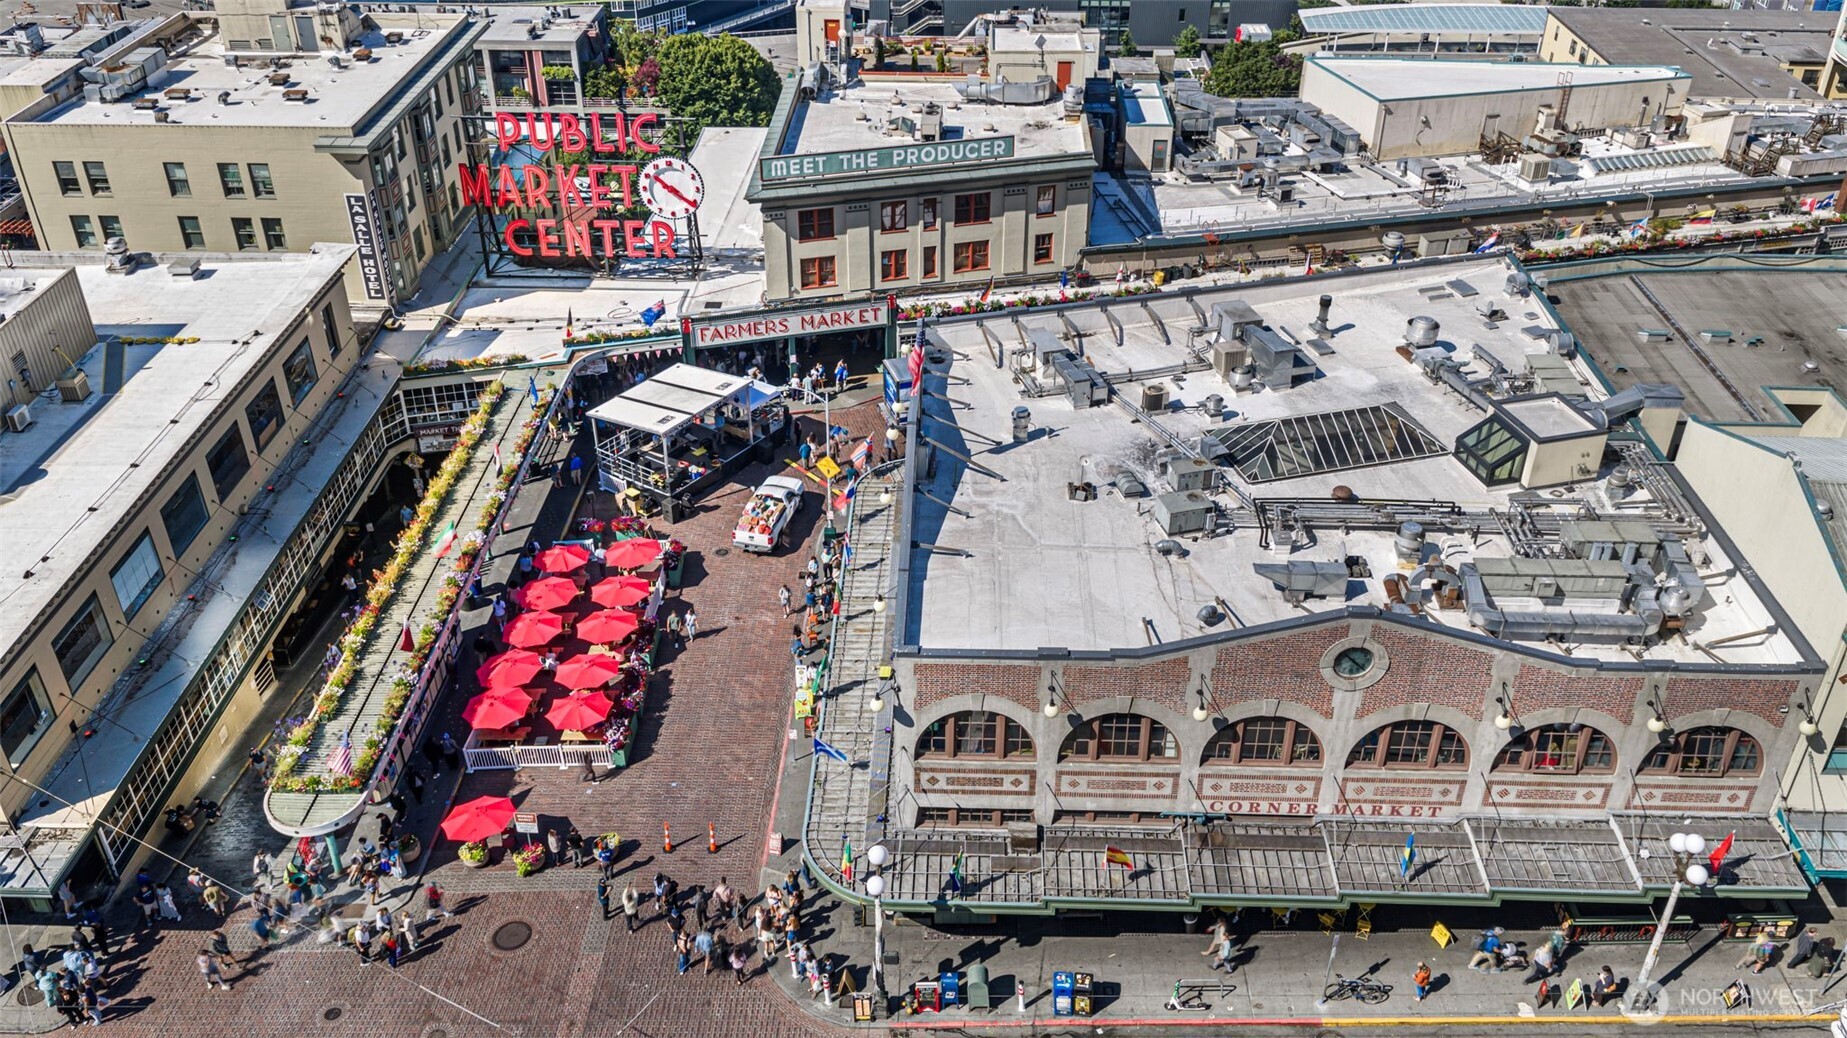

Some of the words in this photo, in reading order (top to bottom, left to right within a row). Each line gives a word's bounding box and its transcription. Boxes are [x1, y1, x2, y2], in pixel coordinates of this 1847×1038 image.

[495, 111, 660, 153] PUBLIC
[770, 156, 827, 177] MEET
[838, 151, 879, 170] THE
[893, 140, 1006, 166] PRODUCER
[458, 163, 638, 208] MARKET
[349, 197, 364, 214] LA
[354, 215, 373, 255] SALLE
[504, 218, 677, 258] CENTER
[362, 259, 382, 297] HOTEL
[700, 318, 789, 342] FARMERS
[801, 307, 882, 330] MARKET
[1209, 801, 1318, 814] CORNER
[1331, 804, 1443, 817] MARKET
